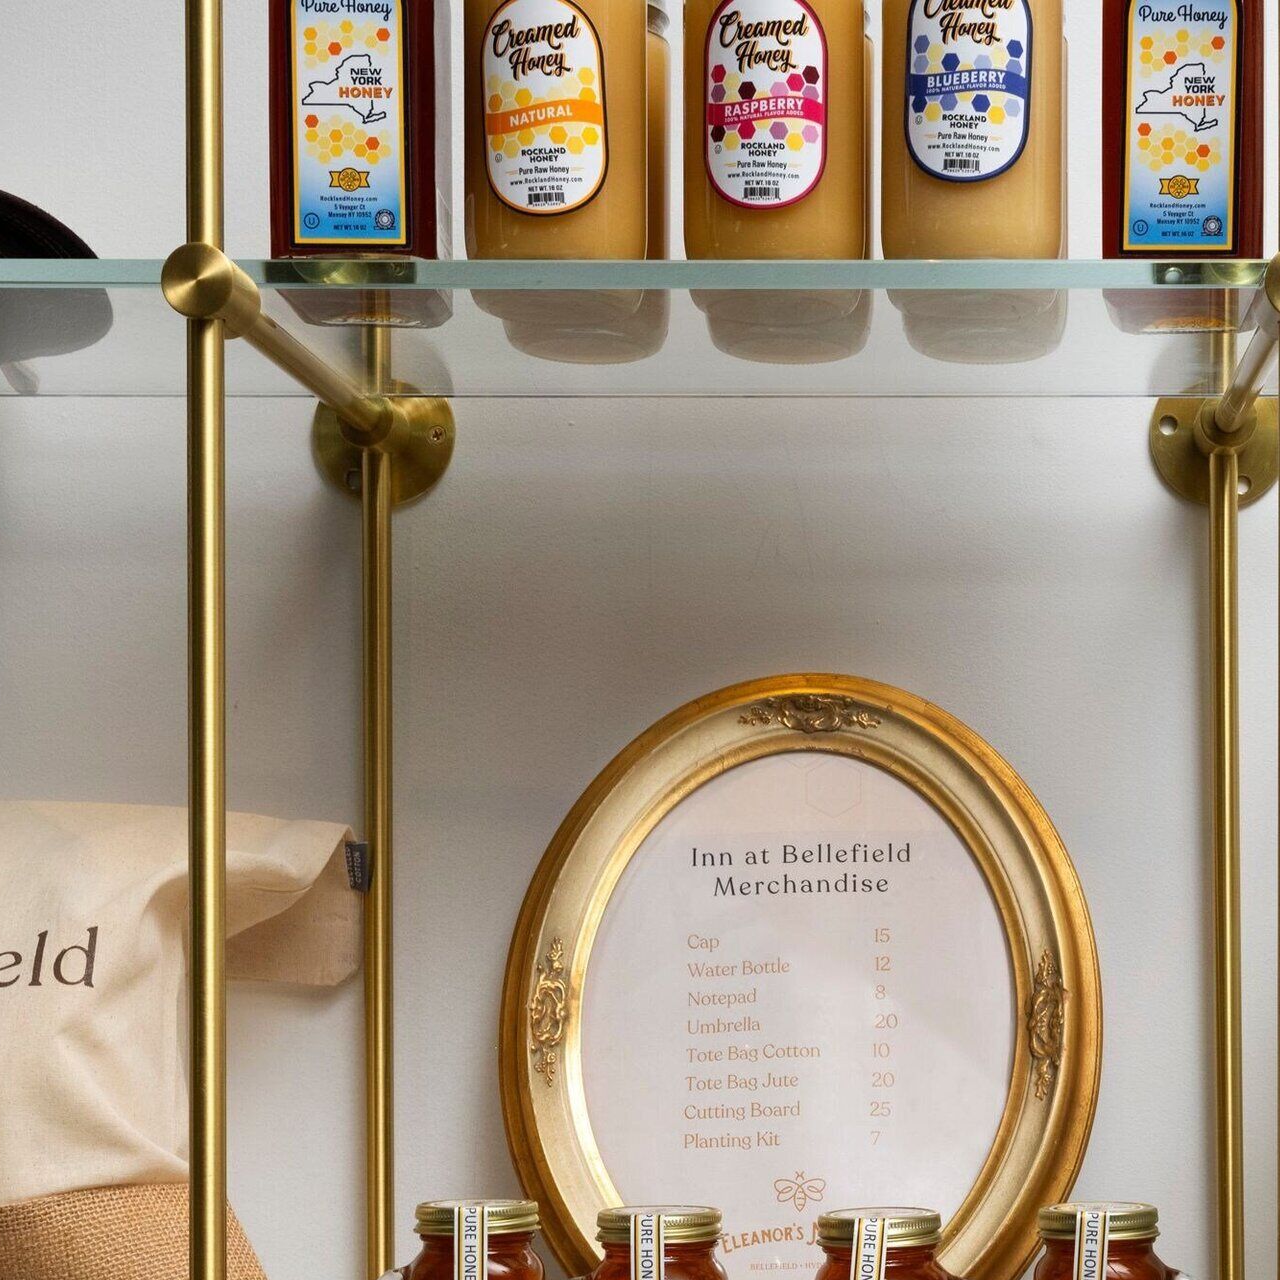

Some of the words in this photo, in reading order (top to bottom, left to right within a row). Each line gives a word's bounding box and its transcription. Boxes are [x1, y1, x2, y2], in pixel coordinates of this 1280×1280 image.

[300, 0, 340, 12] Pure
[340, 0, 392, 21] Honey
[1138, 5, 1176, 21] Pure
[1177, 4, 1228, 30] Honey
[491, 15, 580, 57] Creamed
[719, 11, 808, 47] Creamed
[940, 13, 1001, 45] Honey
[509, 47, 572, 81] Honey
[735, 41, 798, 73] Honey
[351, 76, 382, 85] YORK
[927, 71, 1006, 87] BLUEBERRY
[1185, 85, 1215, 93] YORK
[339, 87, 393, 98] HONEY
[1172, 95, 1225, 106] HONEY
[510, 105, 573, 127] NATURAL
[725, 99, 804, 117] RASPBERRY
[942, 114, 987, 122] ROCKLAND
[968, 132, 988, 143] Honey
[522, 148, 566, 156] ROCKLAND
[534, 166, 548, 174] Raw
[550, 166, 569, 174] Honey
[767, 161, 787, 169] Honey
[692, 848, 733, 867] Inn
[745, 849, 770, 865] at
[782, 843, 911, 864] Bellefield
[714, 873, 889, 897] Merchandise
[688, 934, 720, 952] Cap
[874, 928, 891, 943] 15
[688, 963, 737, 978] Water
[742, 958, 790, 976] Bottle
[874, 956, 891, 971] 12
[688, 989, 757, 1008] Notepad
[875, 985, 886, 999] 8
[687, 1017, 761, 1034] Umbrella
[874, 1014, 898, 1028] 20
[686, 1047, 723, 1062] Tote
[728, 1046, 758, 1062] Bag
[763, 1044, 820, 1059] Cotton
[872, 1044, 890, 1057] 10
[685, 1076, 722, 1091] Tote
[727, 1074, 757, 1091] Bag
[762, 1073, 799, 1088] Jute
[872, 1072, 894, 1087] 20
[684, 1104, 745, 1121] Cutting
[751, 1101, 800, 1118] Board
[870, 1102, 891, 1116] 25
[684, 1134, 752, 1149] Planting
[757, 1131, 780, 1146] Kit
[870, 1132, 880, 1144] 7
[465, 1208, 476, 1239] PURE
[1086, 1212, 1099, 1244] PURE
[722, 1223, 803, 1253] ELEANOR'S
